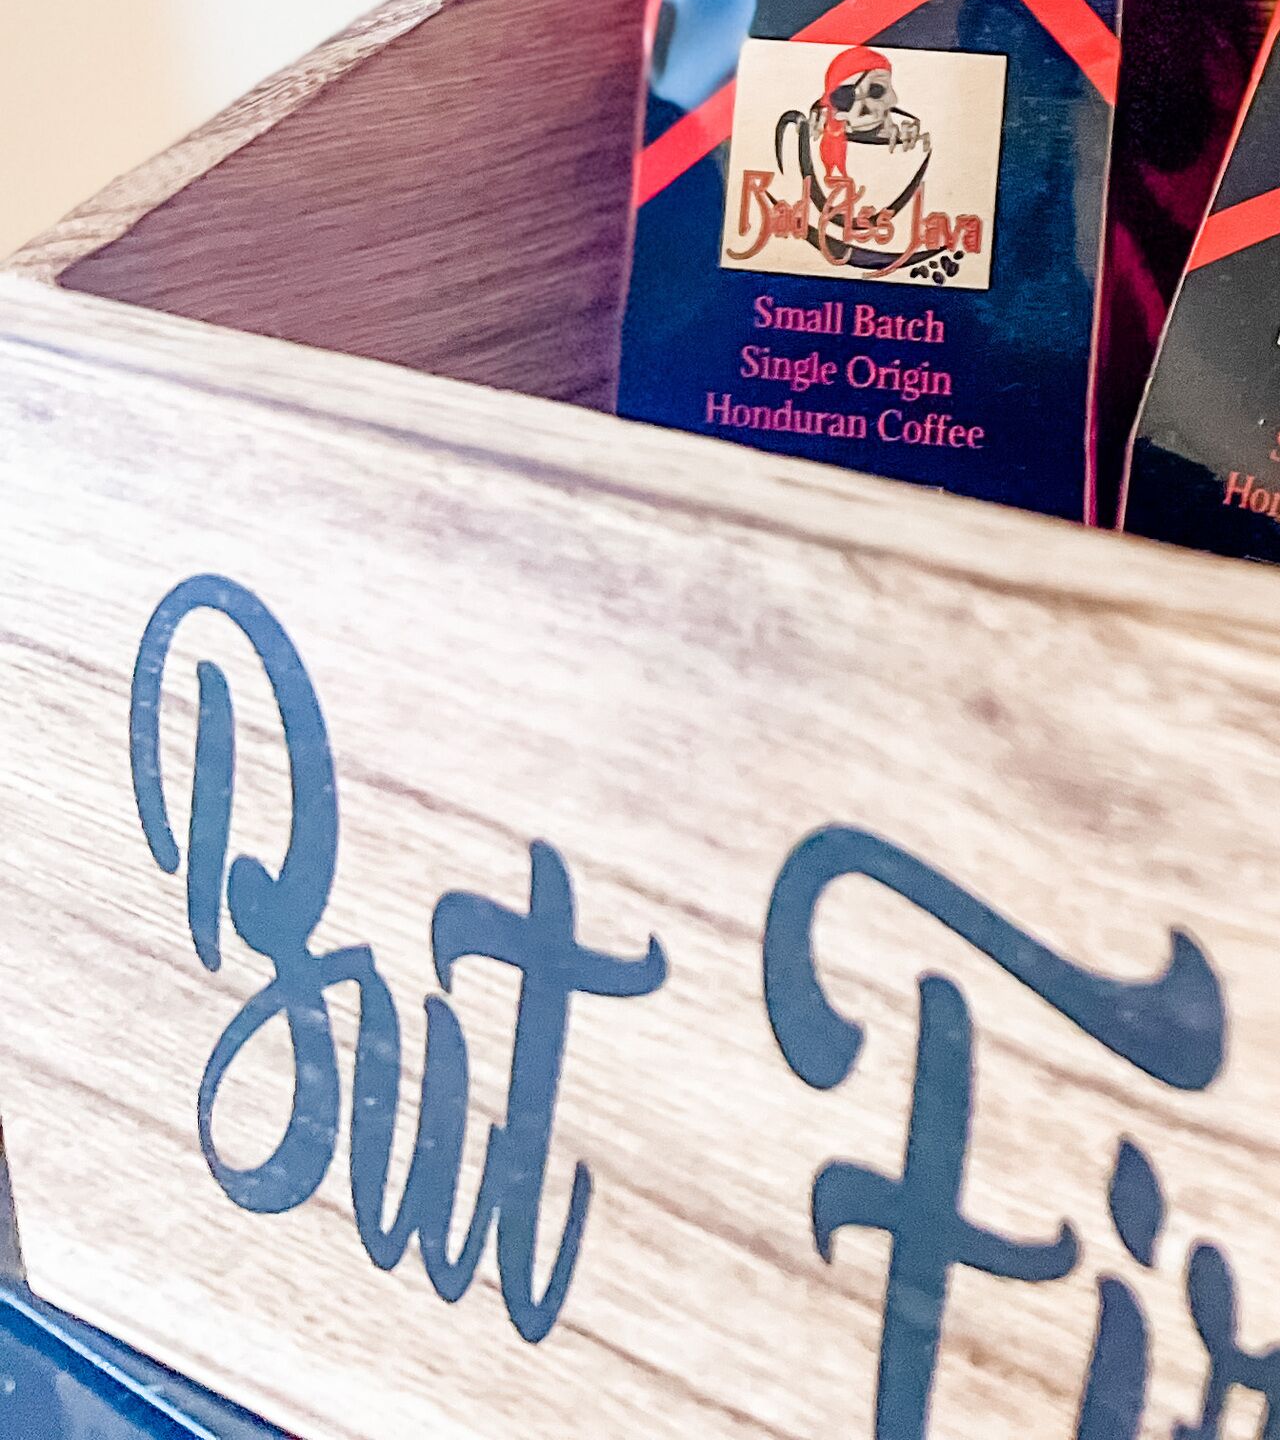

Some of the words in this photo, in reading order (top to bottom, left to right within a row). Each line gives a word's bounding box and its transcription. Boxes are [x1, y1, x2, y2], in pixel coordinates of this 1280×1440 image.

[726, 169, 811, 261] Bad
[817, 175, 896, 266] Ass
[861, 181, 984, 279] Java
[753, 295, 843, 335] Small
[851, 304, 945, 344] Batch
[740, 346, 838, 392] Single
[846, 354, 952, 399] Origin
[704, 391, 867, 440] Honduran
[877, 408, 985, 449] Coffee
[130, 573, 668, 1344] But
